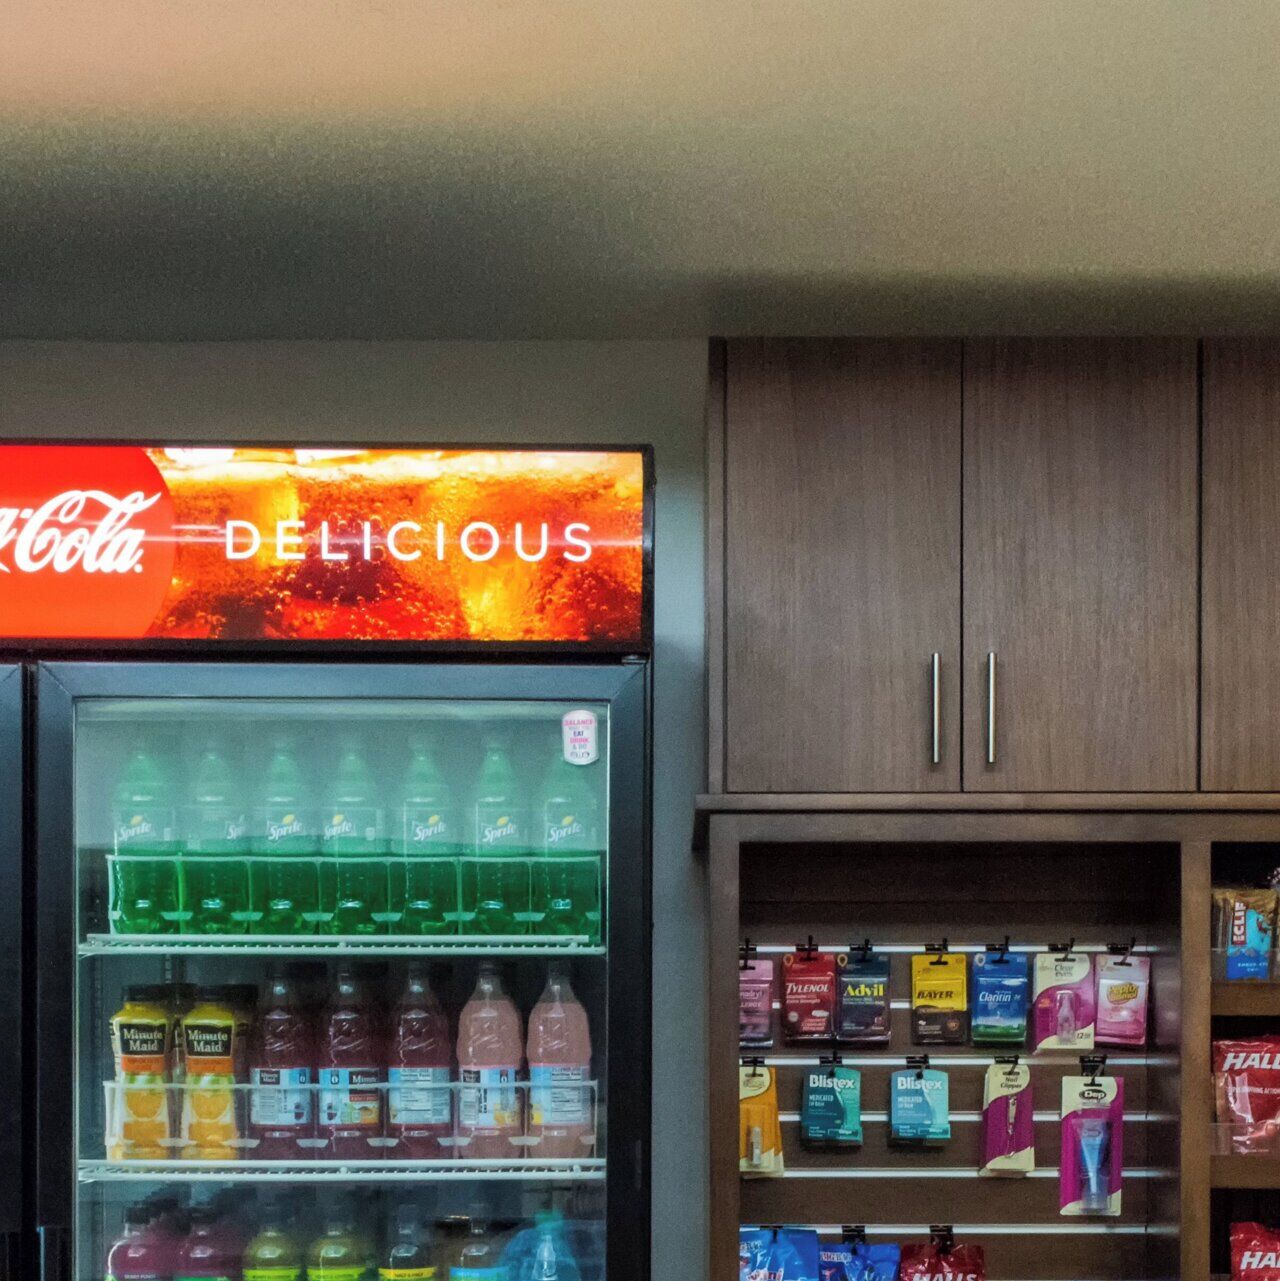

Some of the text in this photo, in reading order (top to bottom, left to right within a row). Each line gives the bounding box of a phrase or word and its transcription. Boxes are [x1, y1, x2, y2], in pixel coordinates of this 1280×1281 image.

[224, 518, 594, 563] DELICIOUS
[119, 822, 153, 842] Sprite
[268, 821, 303, 841] Sprite
[323, 821, 354, 841] Sprite
[414, 821, 447, 842] Sprite
[482, 823, 518, 843] Sprite
[547, 822, 584, 842] Sprite
[785, 983, 830, 994] TYLENOL
[844, 984, 885, 997] Advil
[917, 990, 954, 999] BAYER
[979, 991, 1011, 1002] Claritin
[123, 1028, 163, 1040] Minute
[188, 1029, 228, 1040] Minute
[129, 1040, 158, 1051] Maid
[194, 1041, 223, 1053] Maid
[809, 1074, 855, 1091] Blistex
[897, 1077, 942, 1092] Blistex
[1084, 1090, 1105, 1101] Dep
